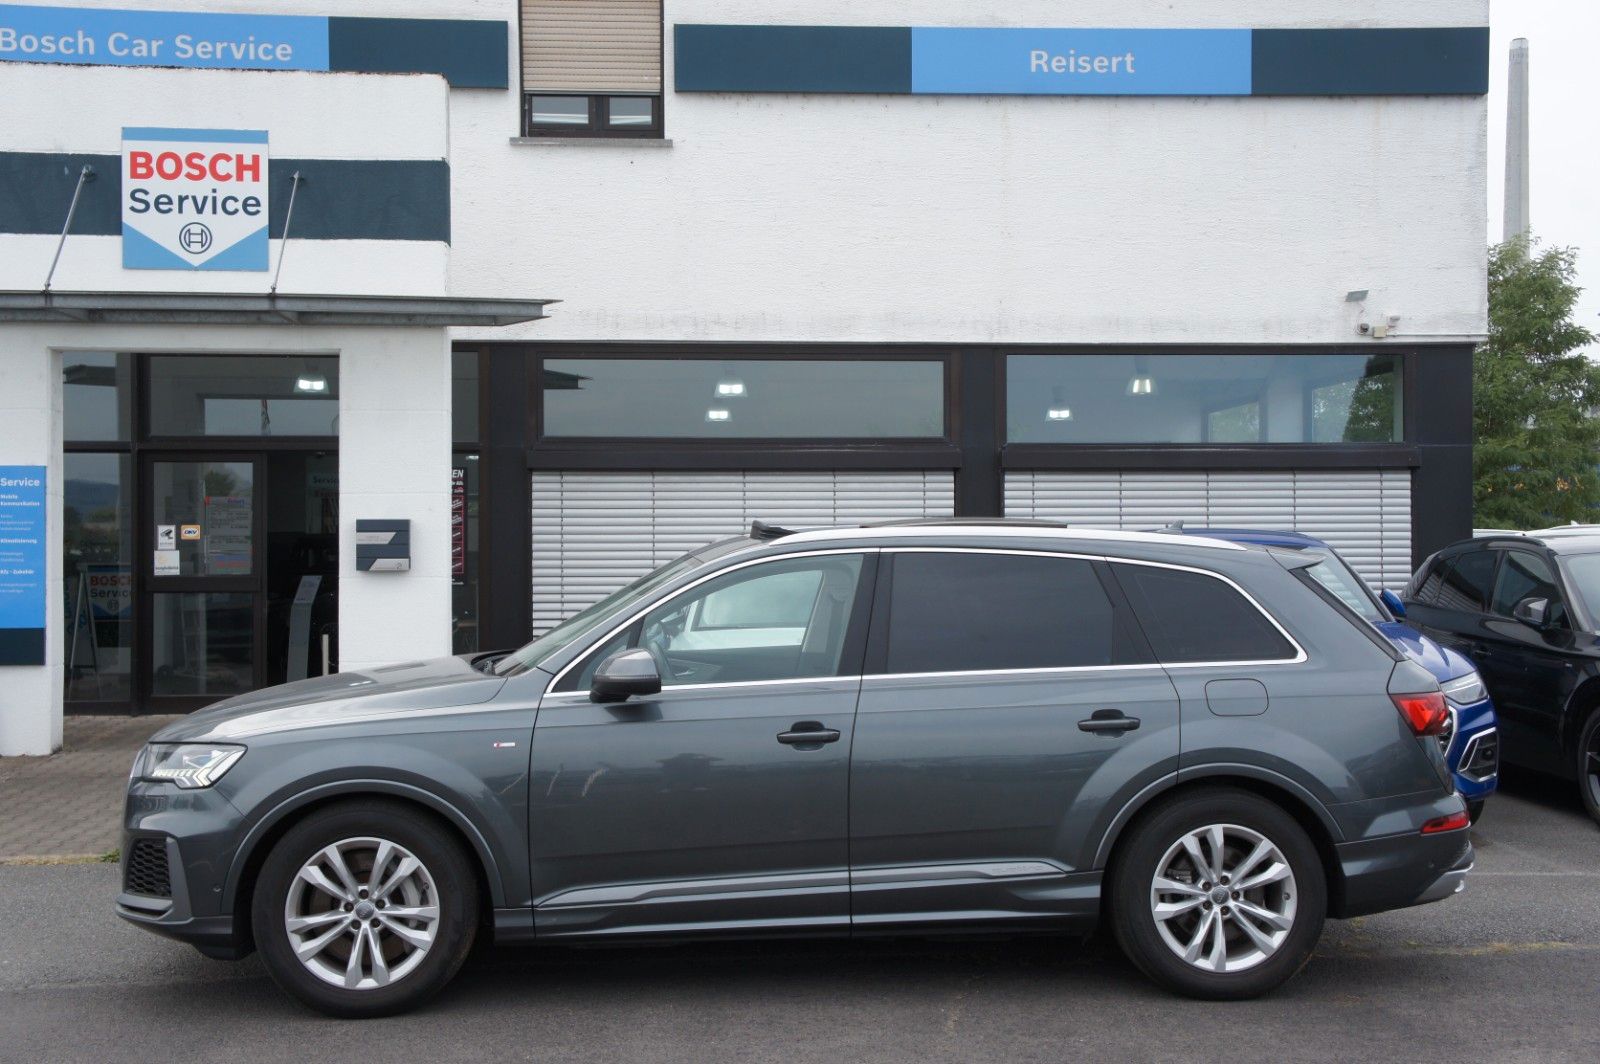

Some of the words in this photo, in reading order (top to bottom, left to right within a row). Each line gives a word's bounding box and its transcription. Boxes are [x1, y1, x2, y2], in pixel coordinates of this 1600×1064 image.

[0, 28, 95, 55] Bosch
[107, 32, 163, 57] Car
[174, 34, 293, 61] Service
[1030, 49, 1135, 73] Reisert
[129, 151, 260, 182] BOSCH
[129, 188, 261, 216] Service
[0, 477, 40, 487] Service
